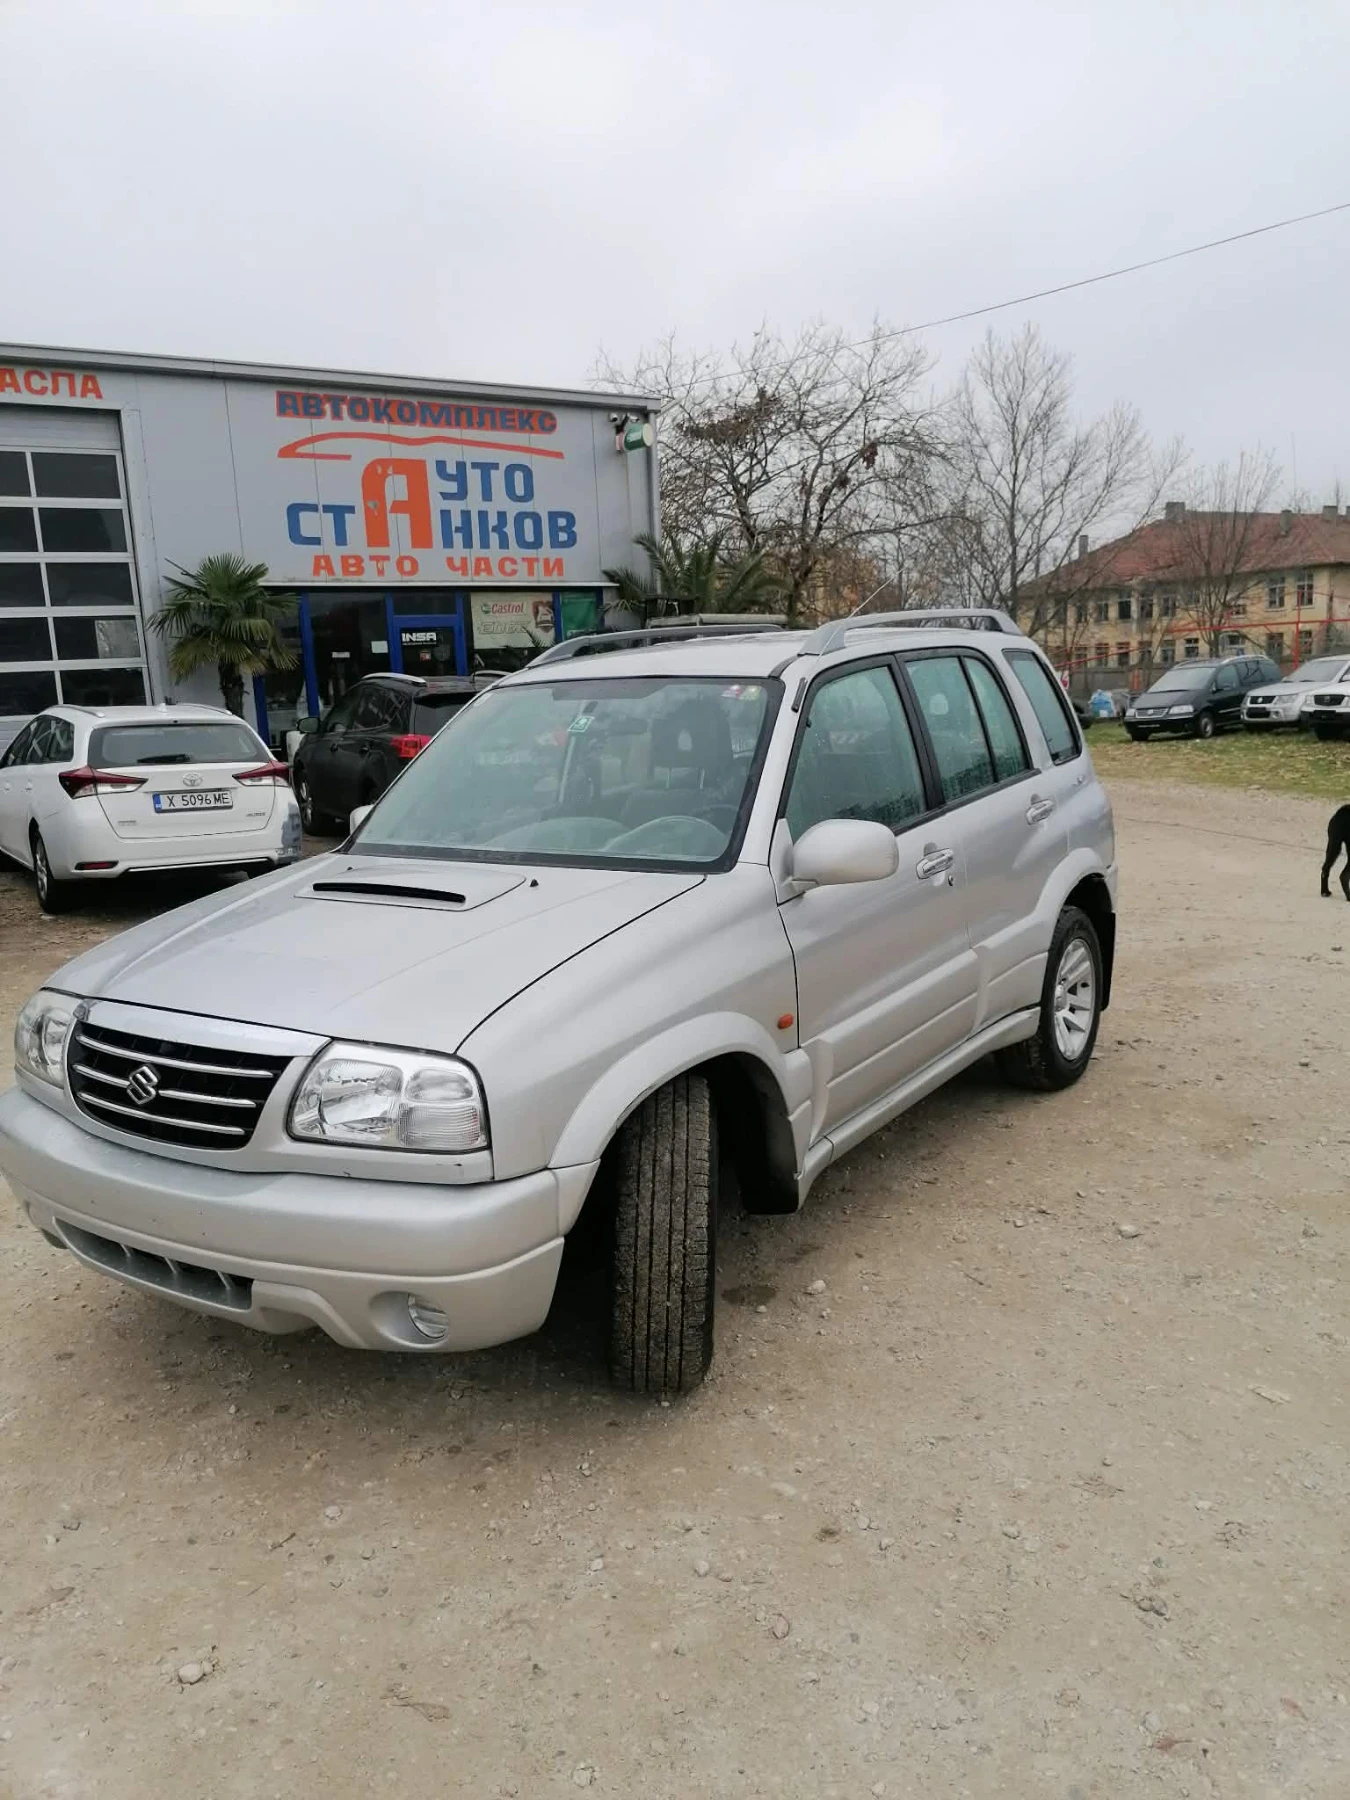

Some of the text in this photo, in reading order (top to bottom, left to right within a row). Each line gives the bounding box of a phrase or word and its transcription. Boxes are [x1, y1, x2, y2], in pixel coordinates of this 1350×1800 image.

[278, 392, 556, 434] АВТОКОМПЛЕКС
[312, 554, 564, 577] АВТО ЧАСТИ
[492, 603, 525, 614] Castrol
[401, 632, 437, 642] INSA
